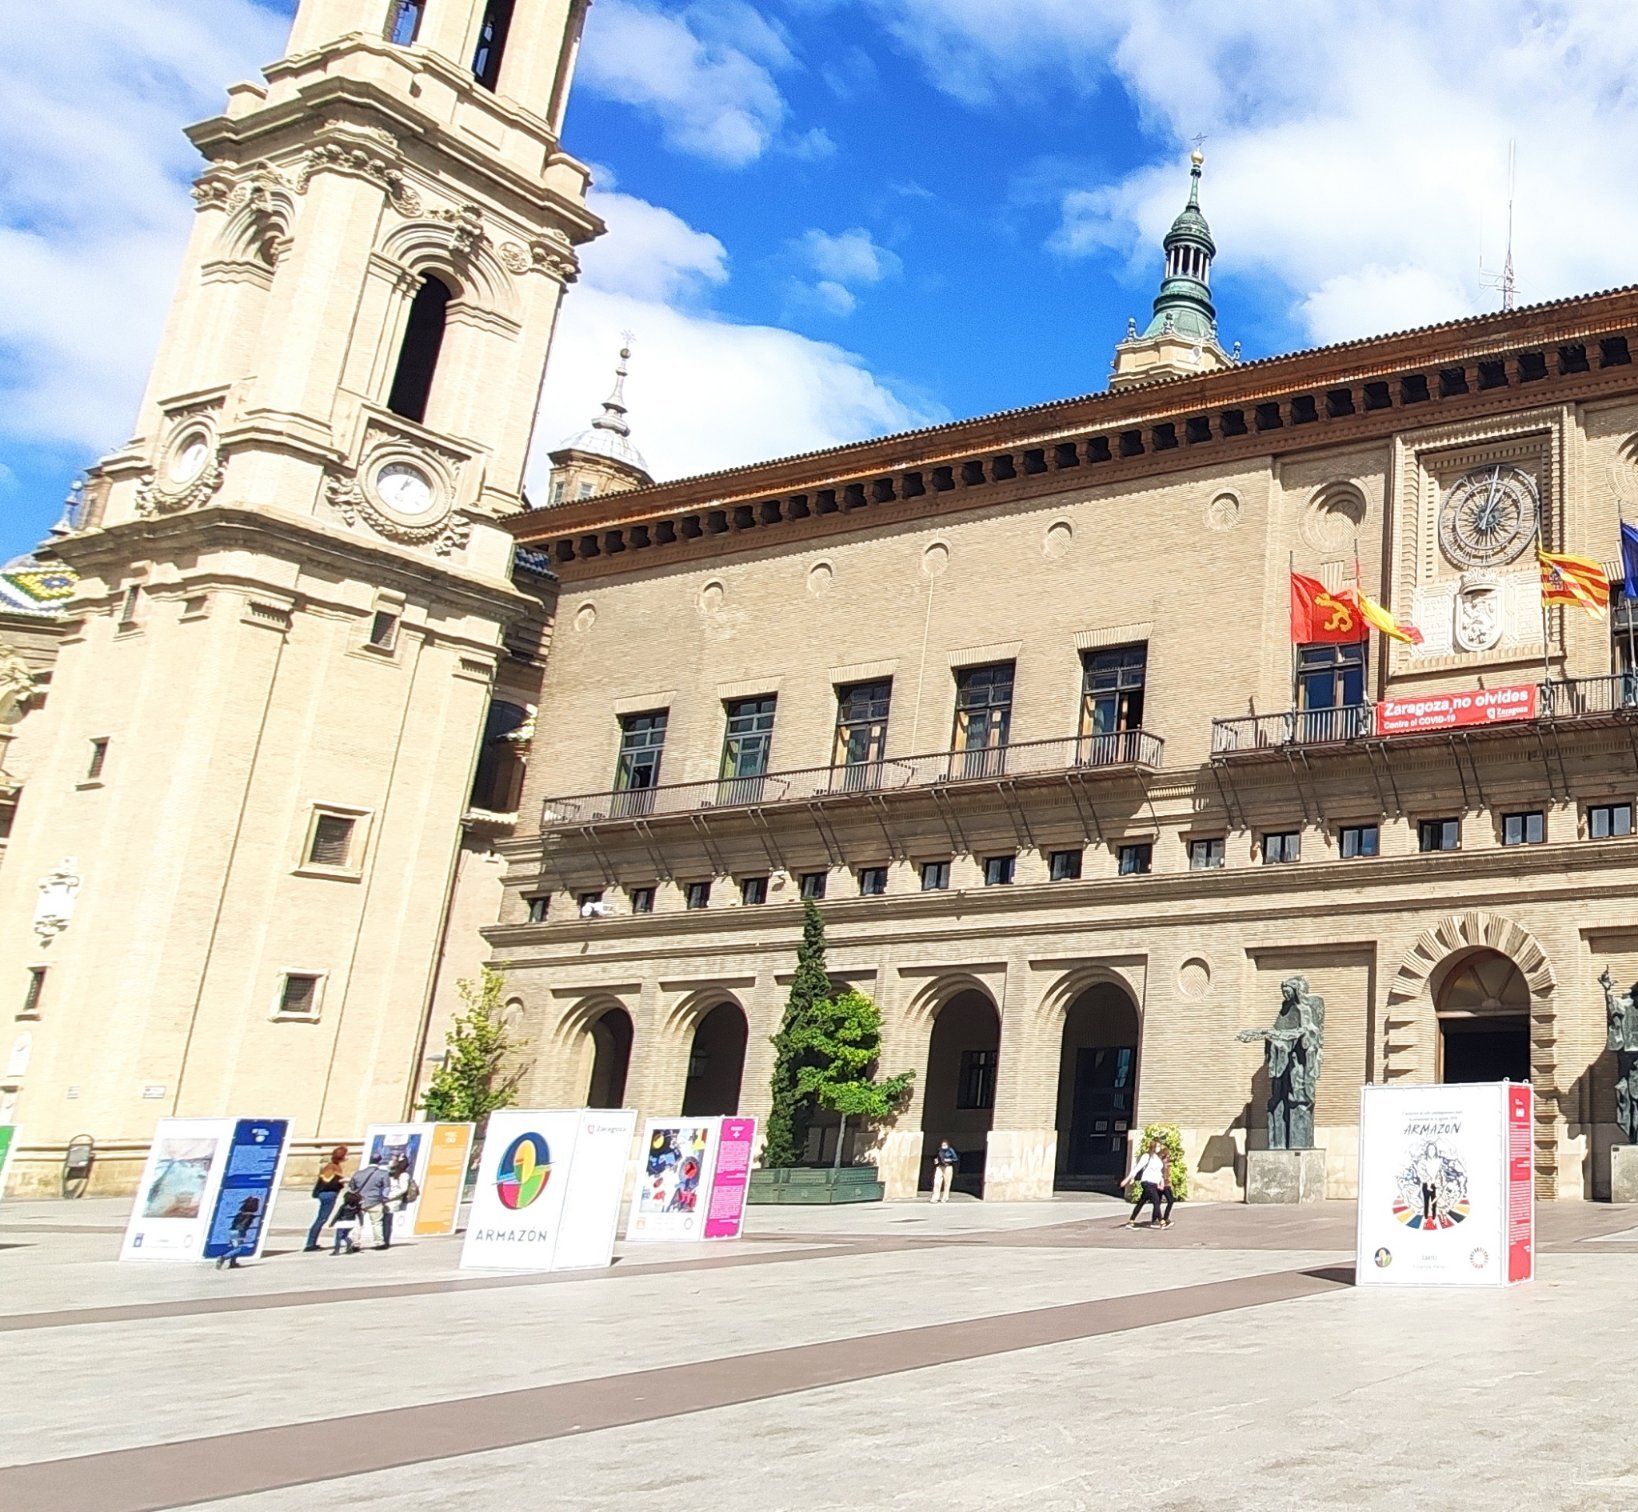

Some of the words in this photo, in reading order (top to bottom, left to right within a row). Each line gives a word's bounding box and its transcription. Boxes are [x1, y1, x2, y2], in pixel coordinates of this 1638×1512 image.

[1475, 690, 1528, 707] olvides
[1497, 707, 1528, 717] Zaragoza
[1384, 720, 1409, 730] Contra
[1410, 718, 1417, 727] el
[1418, 714, 1456, 726] COVID-19
